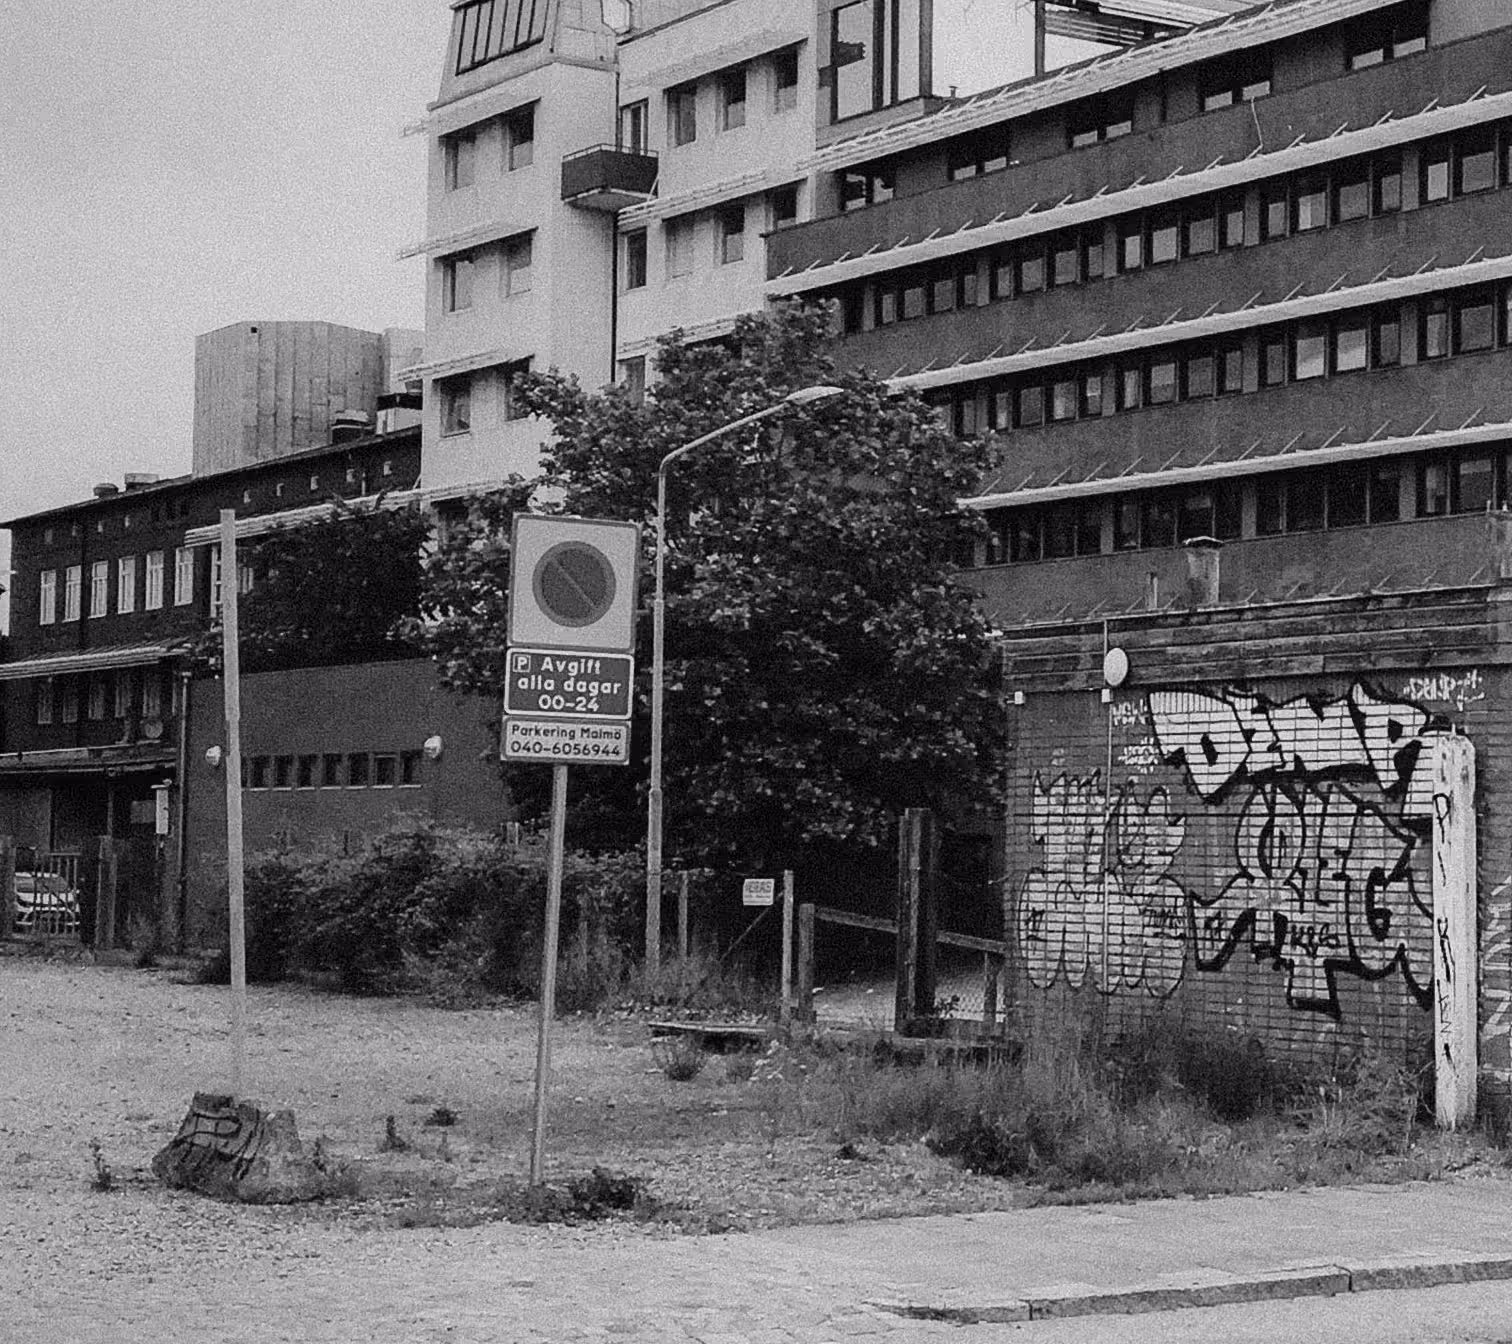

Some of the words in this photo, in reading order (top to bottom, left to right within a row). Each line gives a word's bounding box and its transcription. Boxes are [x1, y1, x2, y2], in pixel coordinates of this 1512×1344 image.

[541, 656, 600, 676] Avgift
[517, 675, 555, 691] alla
[563, 677, 621, 697] dagar
[538, 694, 599, 712] 00-24
[511, 723, 576, 740] Parkering
[580, 727, 621, 741] Malmö
[510, 740, 620, 757] 040-6056944
